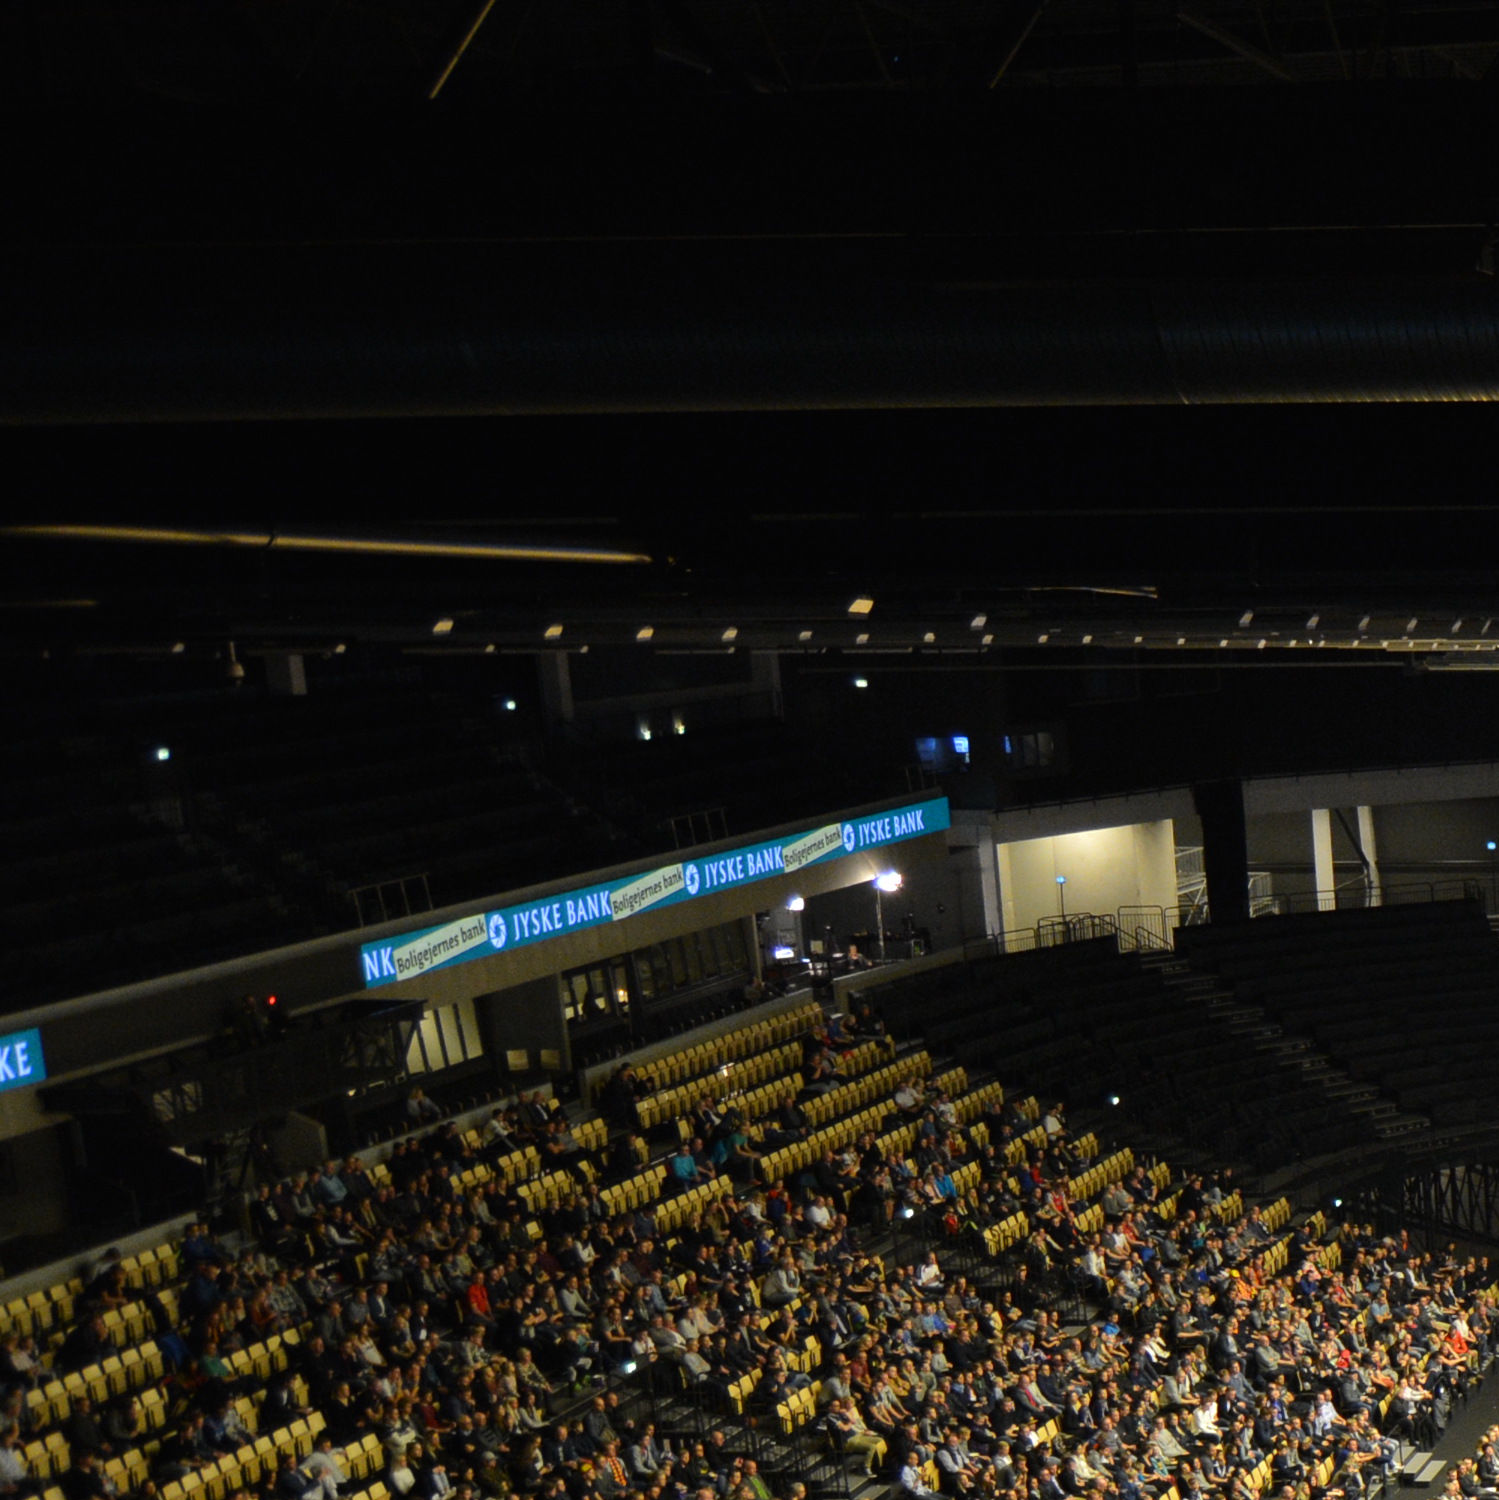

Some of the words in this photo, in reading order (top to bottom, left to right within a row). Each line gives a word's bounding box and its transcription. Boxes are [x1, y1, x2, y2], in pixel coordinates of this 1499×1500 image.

[824, 827, 842, 842] bank
[858, 818, 891, 847] JYSKE
[893, 809, 925, 837] BANK
[704, 858, 744, 888] JYSKE
[747, 845, 785, 876] BANK
[612, 880, 662, 915] Boligejernes
[662, 871, 683, 889] bank
[513, 903, 563, 942] JYSKE
[567, 890, 612, 927] BANK
[363, 946, 396, 981] NK
[396, 931, 460, 975] Boligejernes
[460, 919, 486, 944] bank
